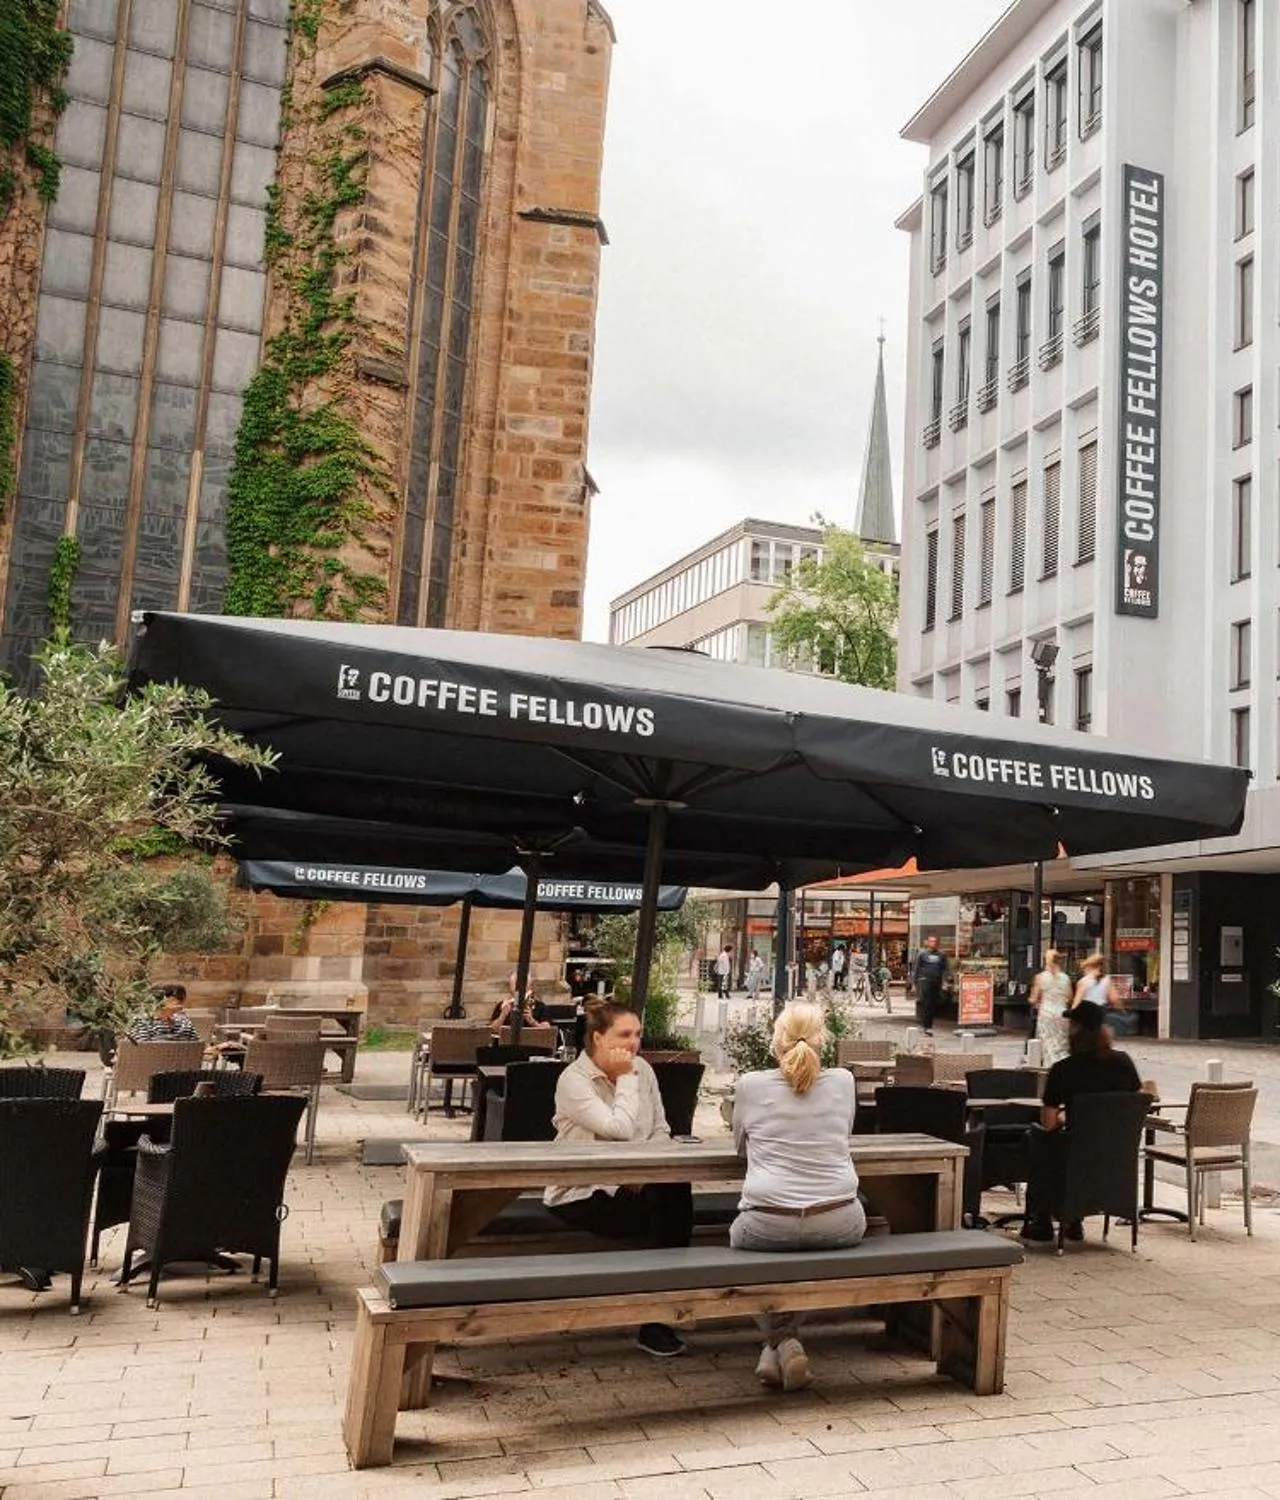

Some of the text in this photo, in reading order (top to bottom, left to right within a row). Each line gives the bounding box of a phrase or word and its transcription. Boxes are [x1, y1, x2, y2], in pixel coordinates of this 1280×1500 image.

[1124, 179, 1158, 542] COFFEE FELLOWS HOTEL
[368, 671, 655, 736] COFFEE FELLOWS
[952, 752, 1155, 800] COFFEE FELLOWS
[307, 868, 426, 889] COFFEE FELLOWS
[537, 883, 643, 901] COFFEE FELLOWS
